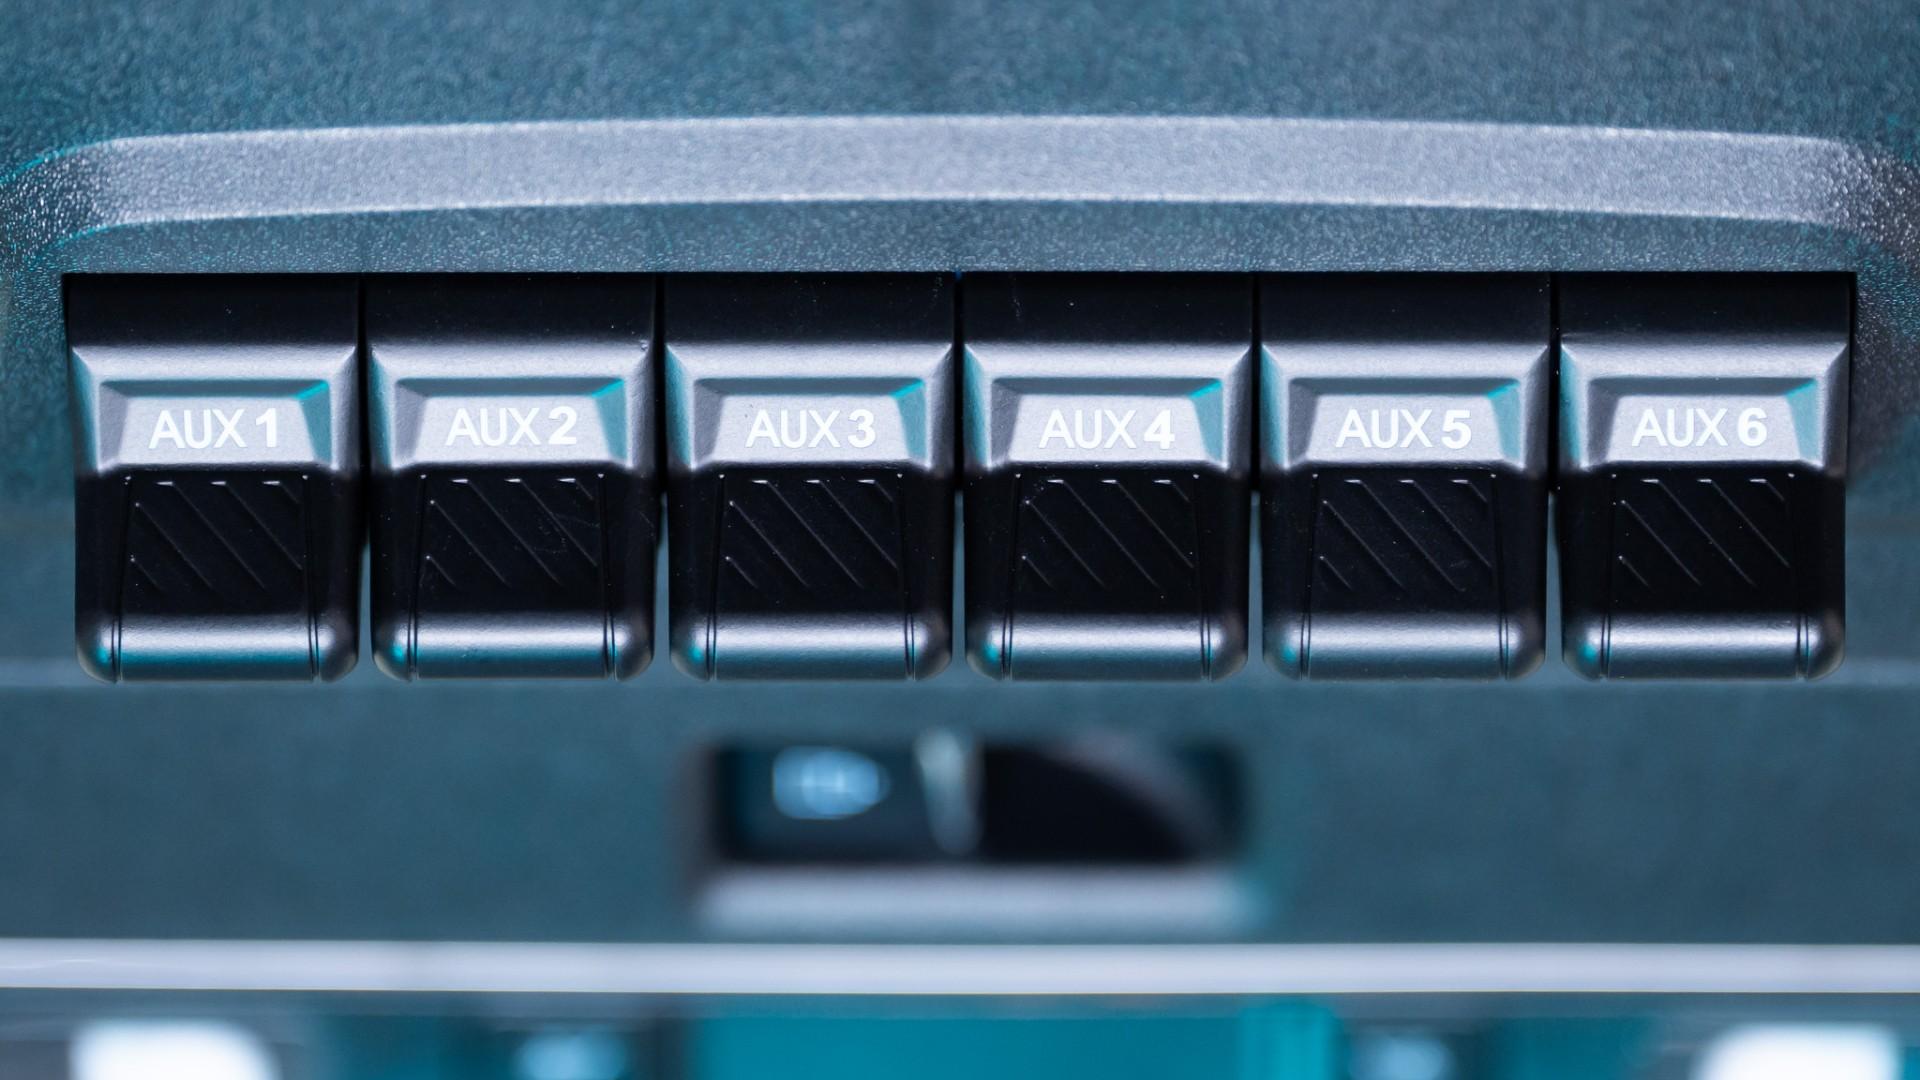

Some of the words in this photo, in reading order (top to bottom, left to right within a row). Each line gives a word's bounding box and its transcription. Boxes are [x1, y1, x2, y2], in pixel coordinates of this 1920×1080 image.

[149, 408, 248, 450] AUX
[256, 408, 281, 448] 1
[445, 406, 543, 447] AUX
[548, 405, 577, 445] 2
[746, 408, 844, 449] AUX
[848, 408, 876, 449] 3
[1039, 408, 1136, 449] AUX
[1142, 408, 1175, 449] 4
[1334, 408, 1433, 449] AUX
[1442, 408, 1471, 449] 5
[1631, 406, 1728, 447] AUX
[1737, 405, 1767, 447] 6
